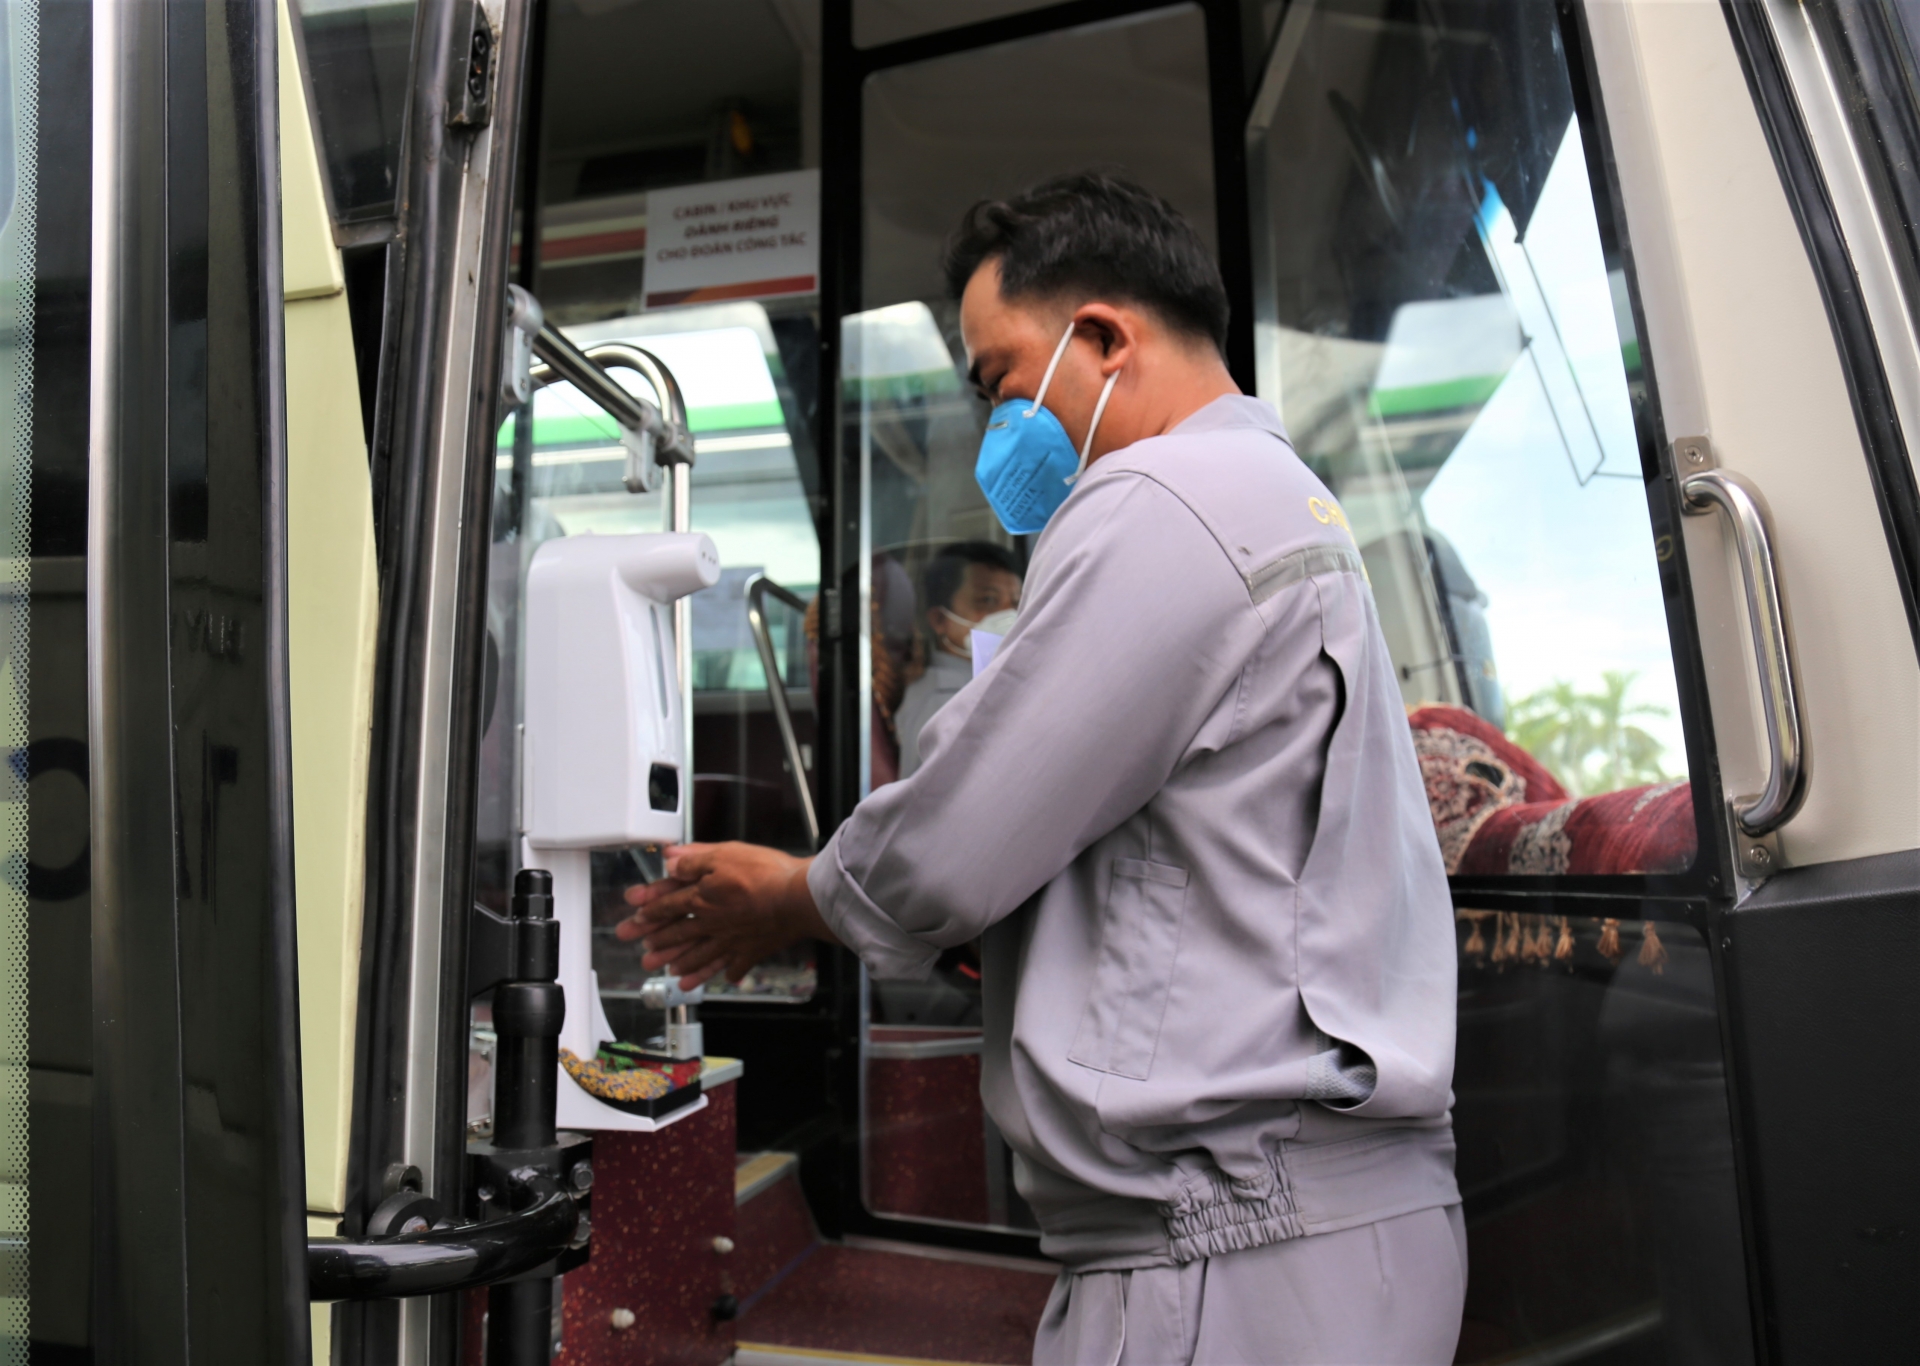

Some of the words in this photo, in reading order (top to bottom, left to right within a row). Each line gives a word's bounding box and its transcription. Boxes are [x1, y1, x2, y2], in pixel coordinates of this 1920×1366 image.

[673, 202, 717, 220] CABIN
[727, 198, 759, 213] KHU
[684, 219, 729, 239] DÀNH
[656, 247, 687, 263] CHO
[736, 236, 777, 255] CÔNG
[779, 231, 806, 247] TÁC
